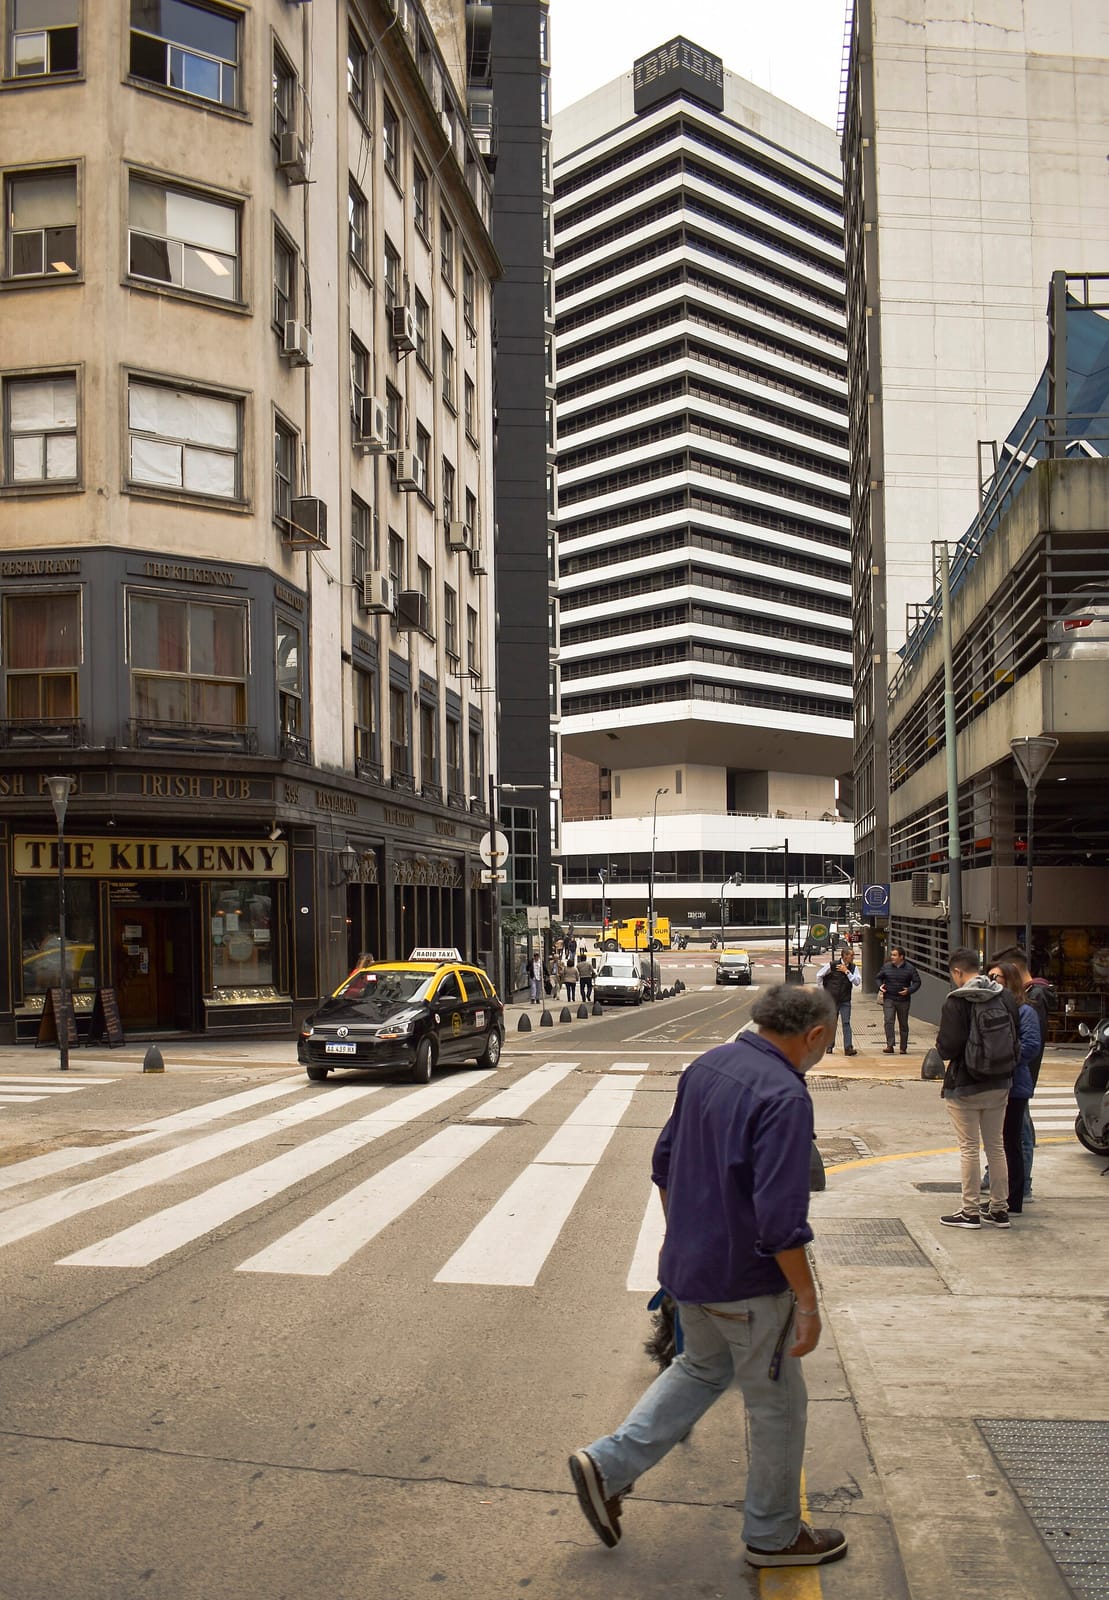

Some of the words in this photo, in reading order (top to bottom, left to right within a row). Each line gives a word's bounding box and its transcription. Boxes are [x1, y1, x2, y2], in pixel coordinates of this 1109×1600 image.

[635, 42, 680, 90] IBM
[681, 42, 723, 88] IBM
[0, 558, 80, 576] RESTAURANT
[144, 561, 170, 578] THE
[171, 565, 235, 586] KILKENNY
[141, 774, 200, 797] IRISH
[211, 776, 250, 799] PUB
[25, 841, 95, 869] THE
[109, 843, 280, 872] KILKENNY
